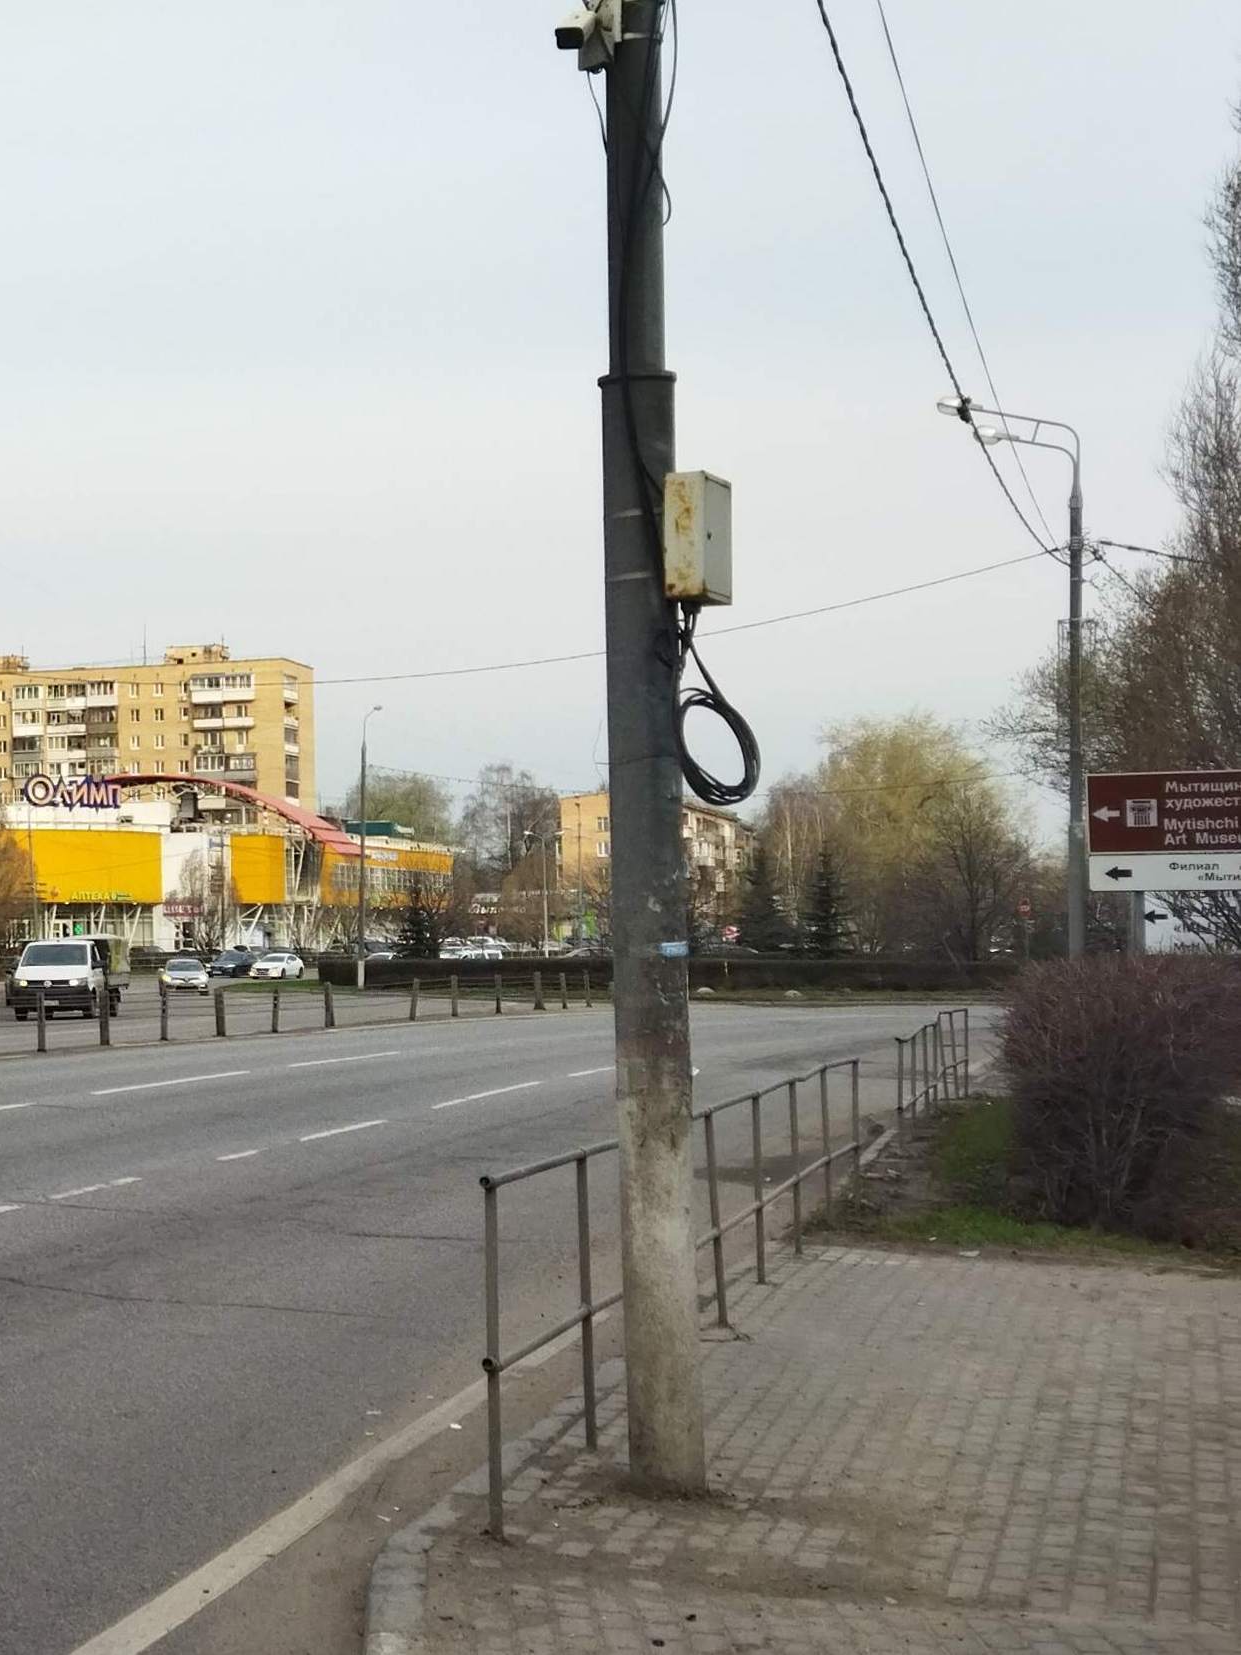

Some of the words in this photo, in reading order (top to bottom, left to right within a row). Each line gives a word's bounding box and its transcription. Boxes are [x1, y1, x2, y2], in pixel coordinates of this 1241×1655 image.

[1163, 816, 1239, 833] Mytishchi
[1164, 833, 1188, 846] Art
[1168, 862, 1220, 871] Филиал
